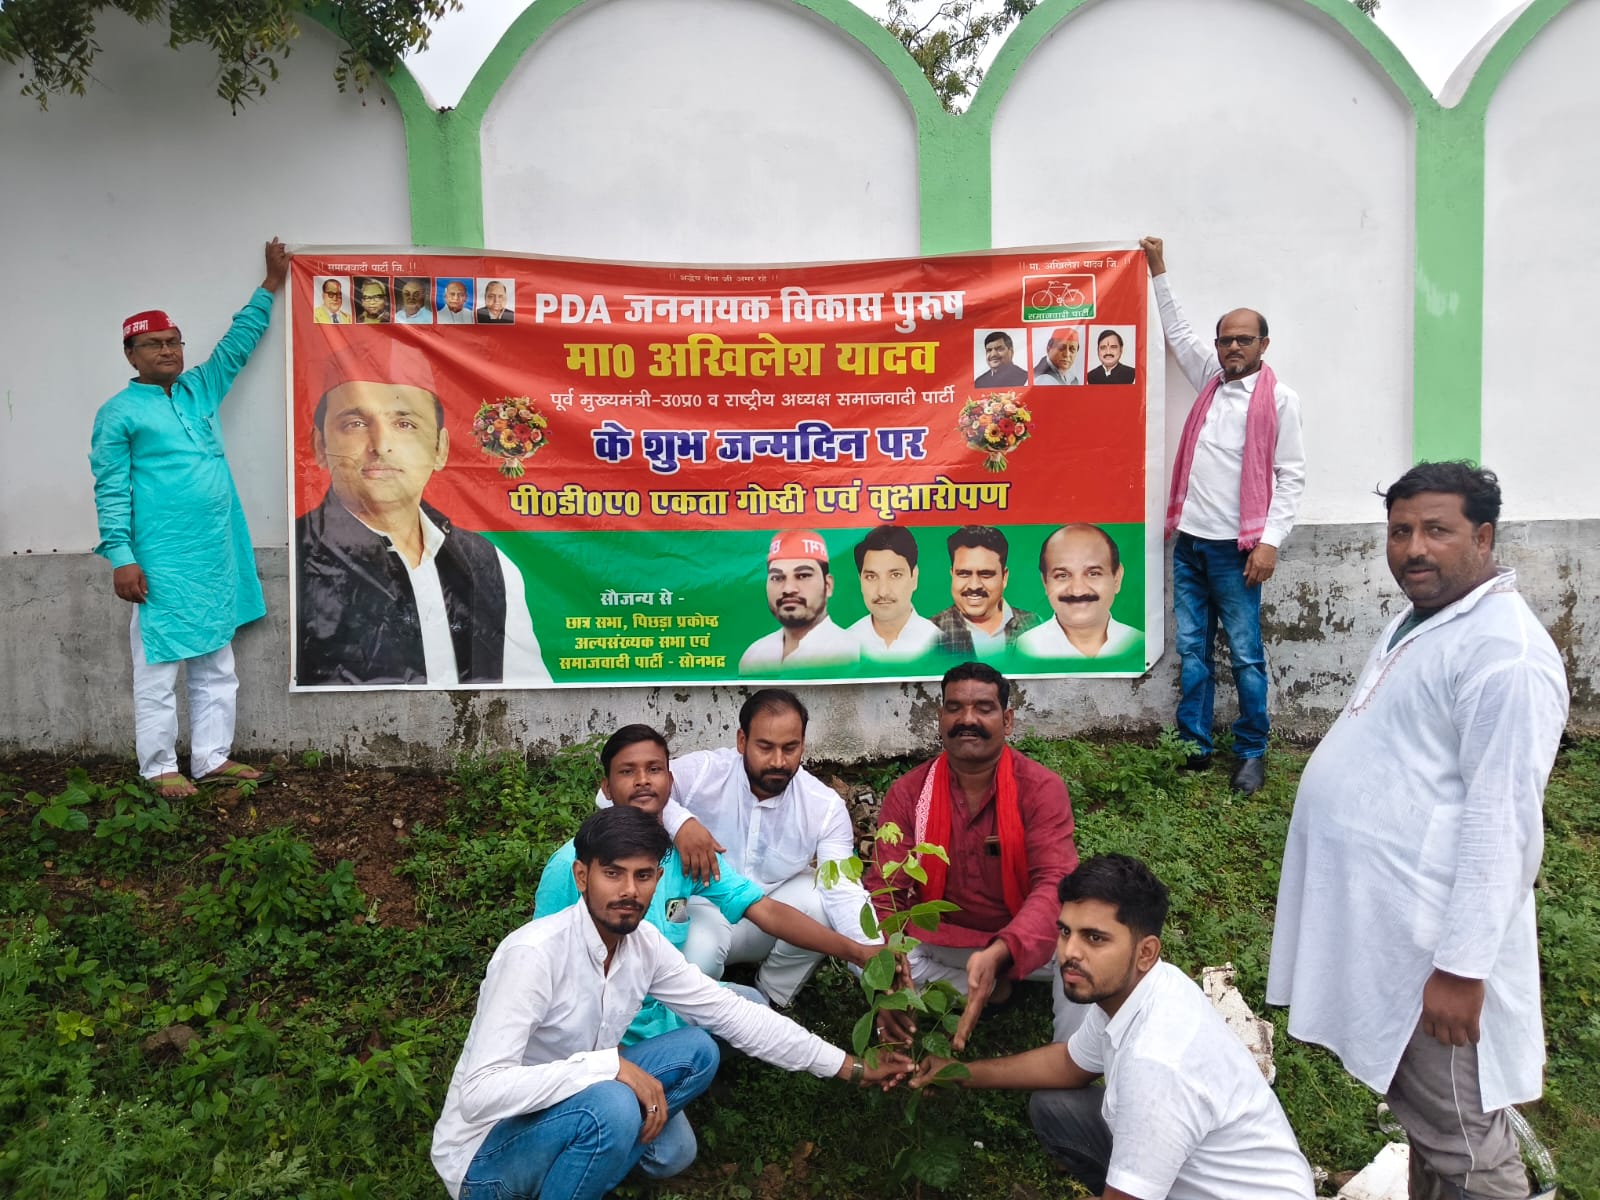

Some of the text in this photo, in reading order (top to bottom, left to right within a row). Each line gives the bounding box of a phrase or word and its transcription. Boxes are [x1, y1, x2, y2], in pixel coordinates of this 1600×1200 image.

[327, 261, 368, 272] समाजवादी
[371, 261, 389, 272] पार्टी
[1045, 258, 1080, 270] अखिलेश
[1083, 260, 1103, 269] यादव
[535, 293, 611, 324] PDA
[623, 294, 771, 324] जननायक
[780, 286, 884, 323] विकास
[649, 333, 825, 377] अखिलेश
[836, 341, 940, 376] यादव
[550, 388, 575, 411] पूर्व
[707, 394, 719, 408] व
[724, 389, 775, 411] राष्ट्रीय
[781, 392, 831, 407] अध्यक्ष
[836, 387, 916, 406] समाजवादी
[921, 385, 955, 404] पार्टी
[591, 420, 929, 475] के शुभ जन्मदिन पर
[648, 489, 730, 516] एकता
[813, 479, 862, 514] एवं
[867, 476, 1011, 521] वृक्षारोपण
[600, 588, 654, 606] सौजन्य
[659, 587, 674, 606] से
[565, 616, 592, 629] छात्र
[632, 612, 673, 632] पिछड़ा
[677, 612, 720, 629] प्रकोष्ठ
[575, 632, 711, 650] अल्पसंख्यक सभा एवं
[559, 652, 630, 670] समाजवादी
[635, 652, 664, 669] पार्टी
[679, 652, 727, 668] सोनभद्र
